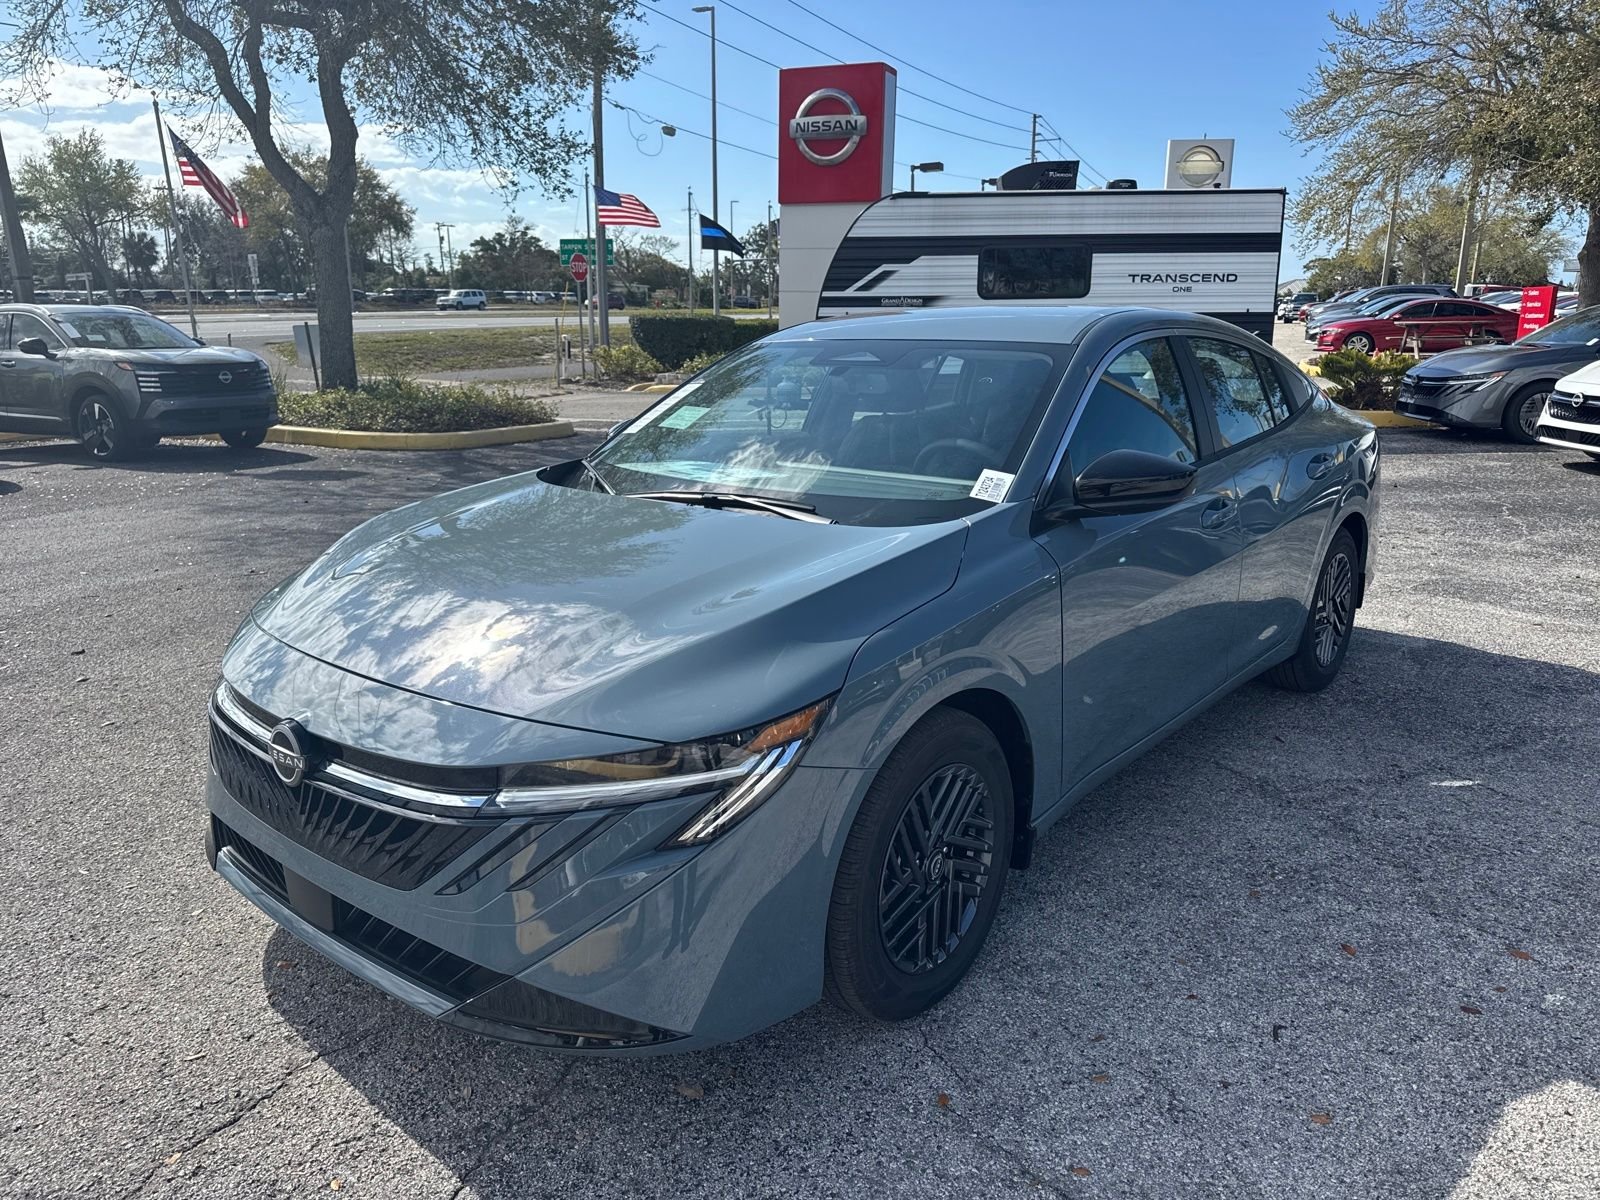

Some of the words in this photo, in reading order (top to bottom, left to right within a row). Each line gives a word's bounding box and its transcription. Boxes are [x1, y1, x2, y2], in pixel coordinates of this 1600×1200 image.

[795, 119, 858, 133] NISSAN
[572, 262, 587, 273] STOP
[1128, 273, 1238, 283] TRANSCEND
